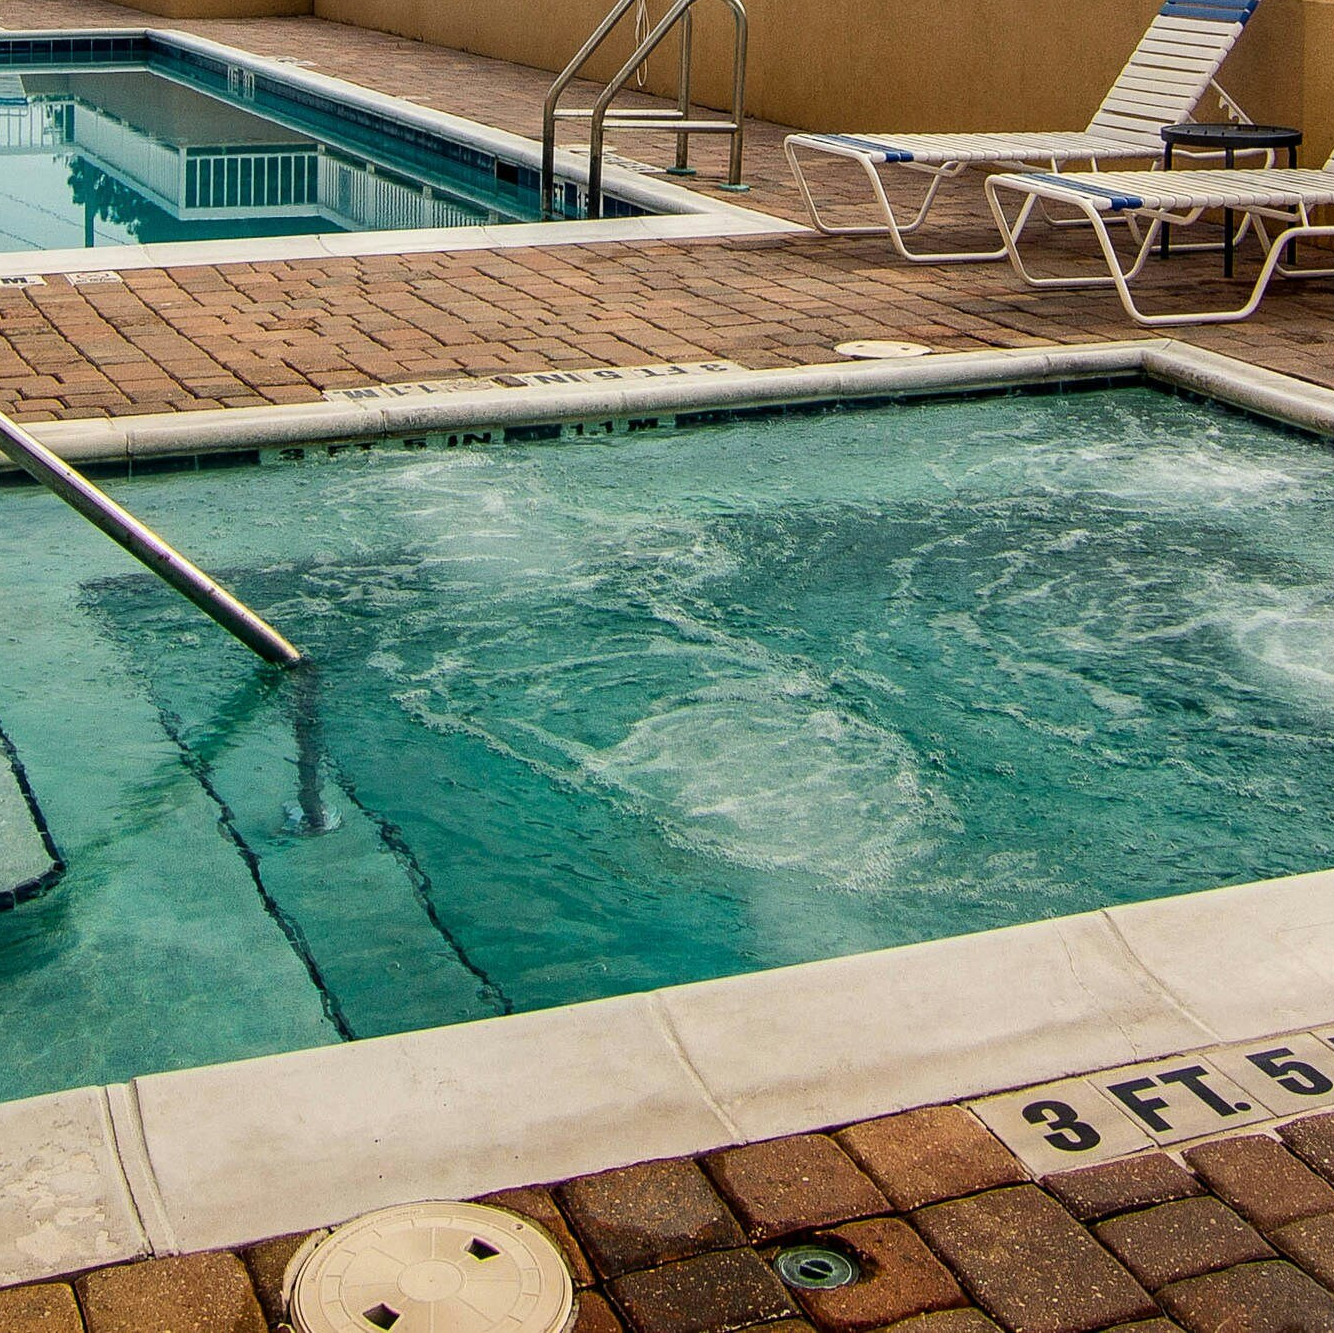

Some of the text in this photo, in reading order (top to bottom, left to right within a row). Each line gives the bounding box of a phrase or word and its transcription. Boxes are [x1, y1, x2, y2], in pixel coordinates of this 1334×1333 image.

[699, 363, 728, 372] 3
[593, 370, 623, 380] 5
[1020, 1099, 1102, 1154] 3
[1106, 1065, 1252, 1133] FT.
[1244, 1047, 1334, 1097] 5
